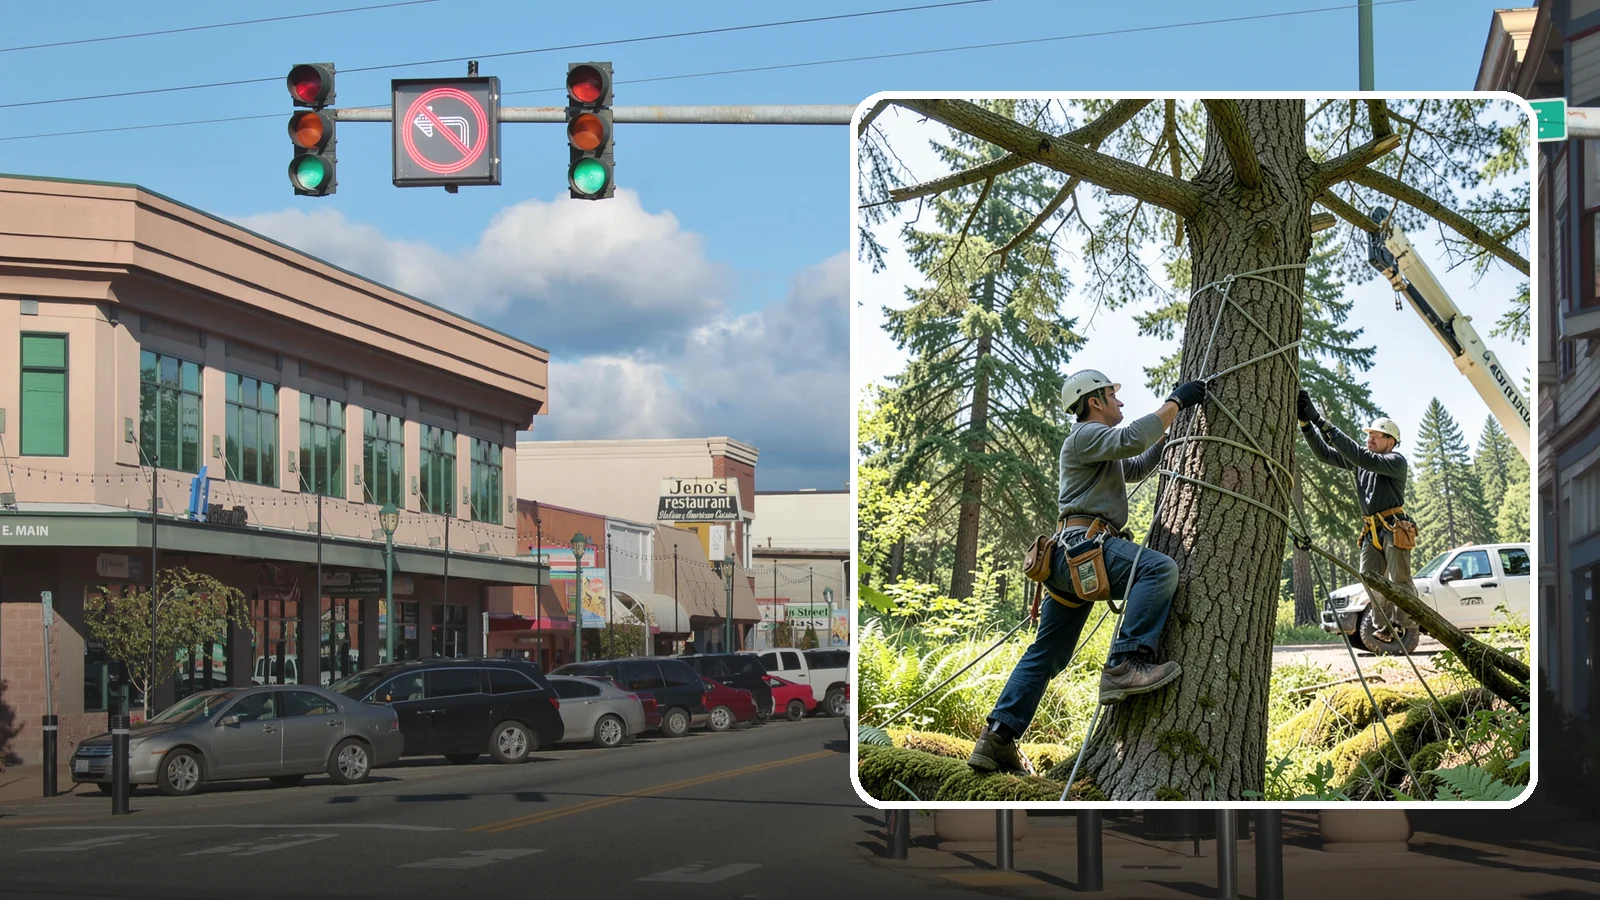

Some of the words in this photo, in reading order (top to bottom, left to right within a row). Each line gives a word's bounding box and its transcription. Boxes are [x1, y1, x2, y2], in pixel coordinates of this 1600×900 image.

[670, 480, 727, 494] Jeno's
[665, 496, 731, 509] restaurant
[659, 510, 681, 520] Italian
[686, 509, 714, 519] American
[715, 509, 737, 519] Cuisine
[2, 525, 13, 536] E.
[16, 525, 49, 536] MAIN
[797, 607, 828, 617] Street
